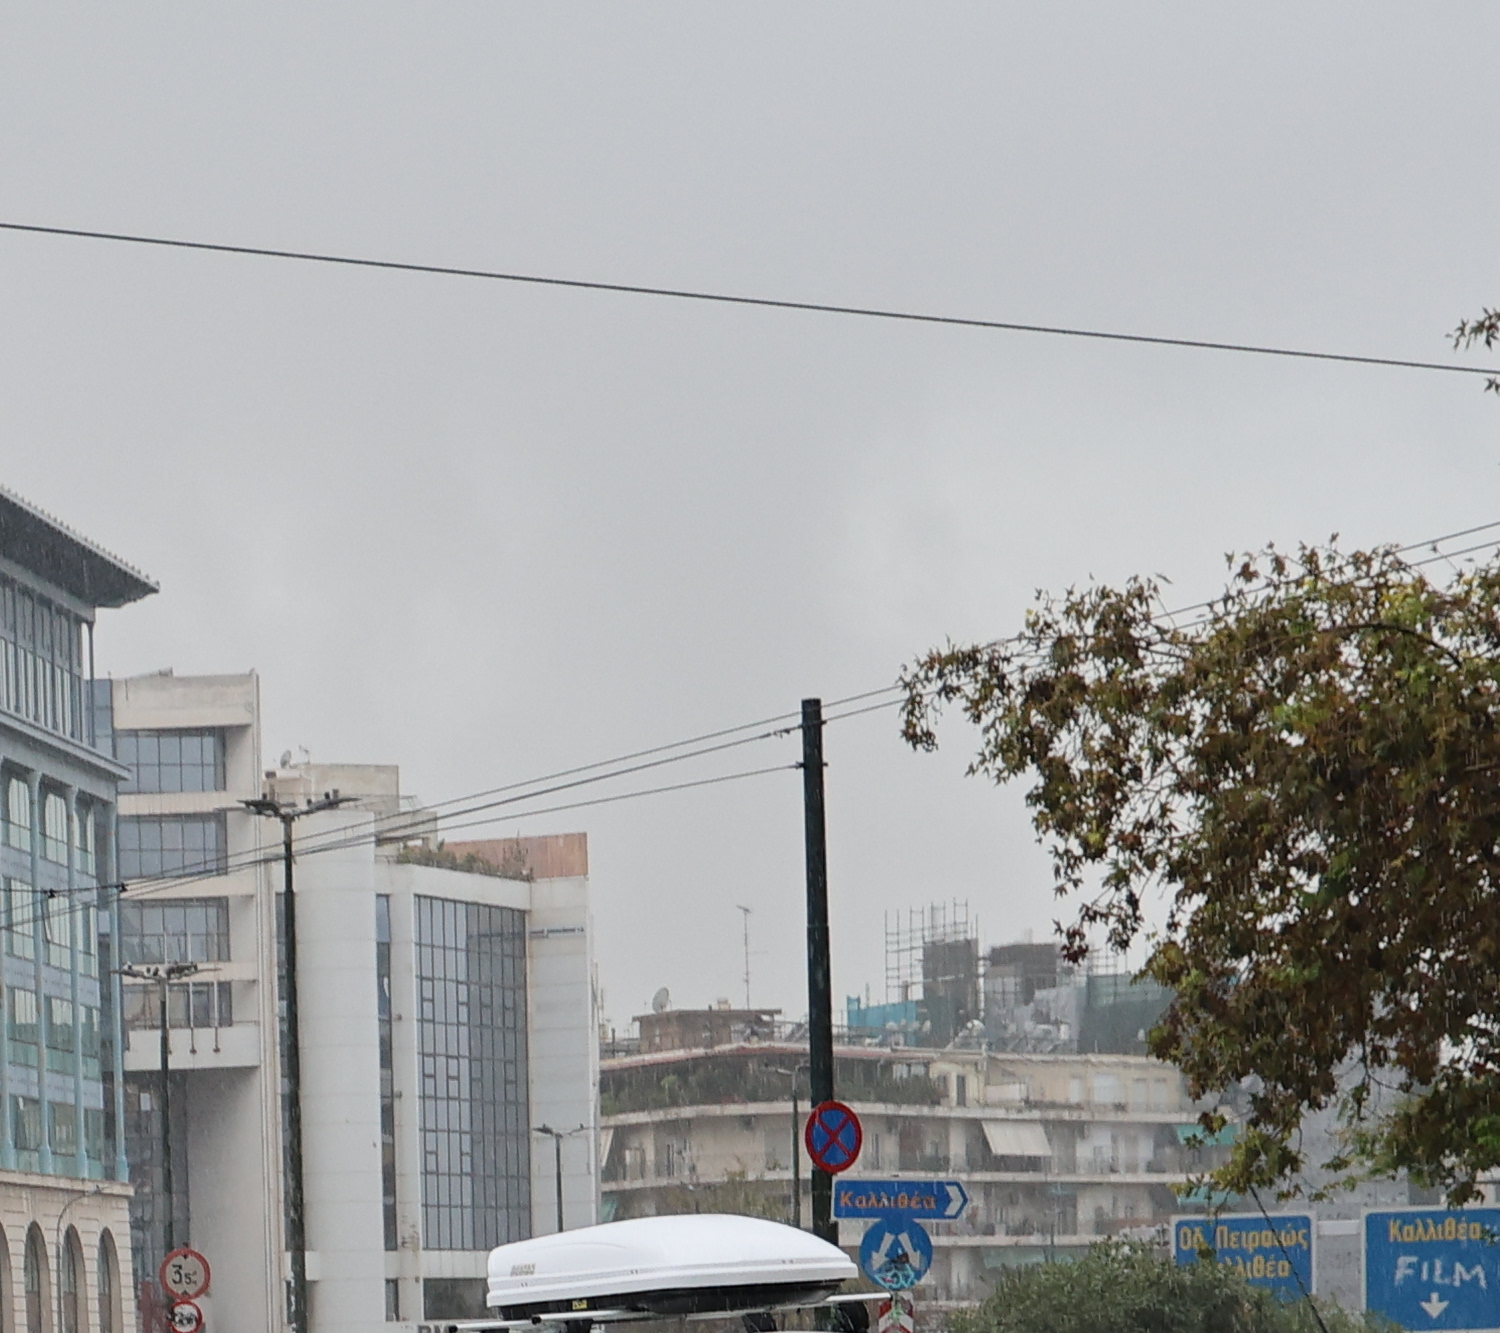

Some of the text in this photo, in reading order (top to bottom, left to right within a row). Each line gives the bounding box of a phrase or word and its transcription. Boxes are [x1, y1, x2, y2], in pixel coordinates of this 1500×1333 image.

[839, 1190, 936, 1210] Καλλιθέα
[1388, 1217, 1482, 1243] Καλλιθέα
[1394, 1255, 1488, 1290] FILM
